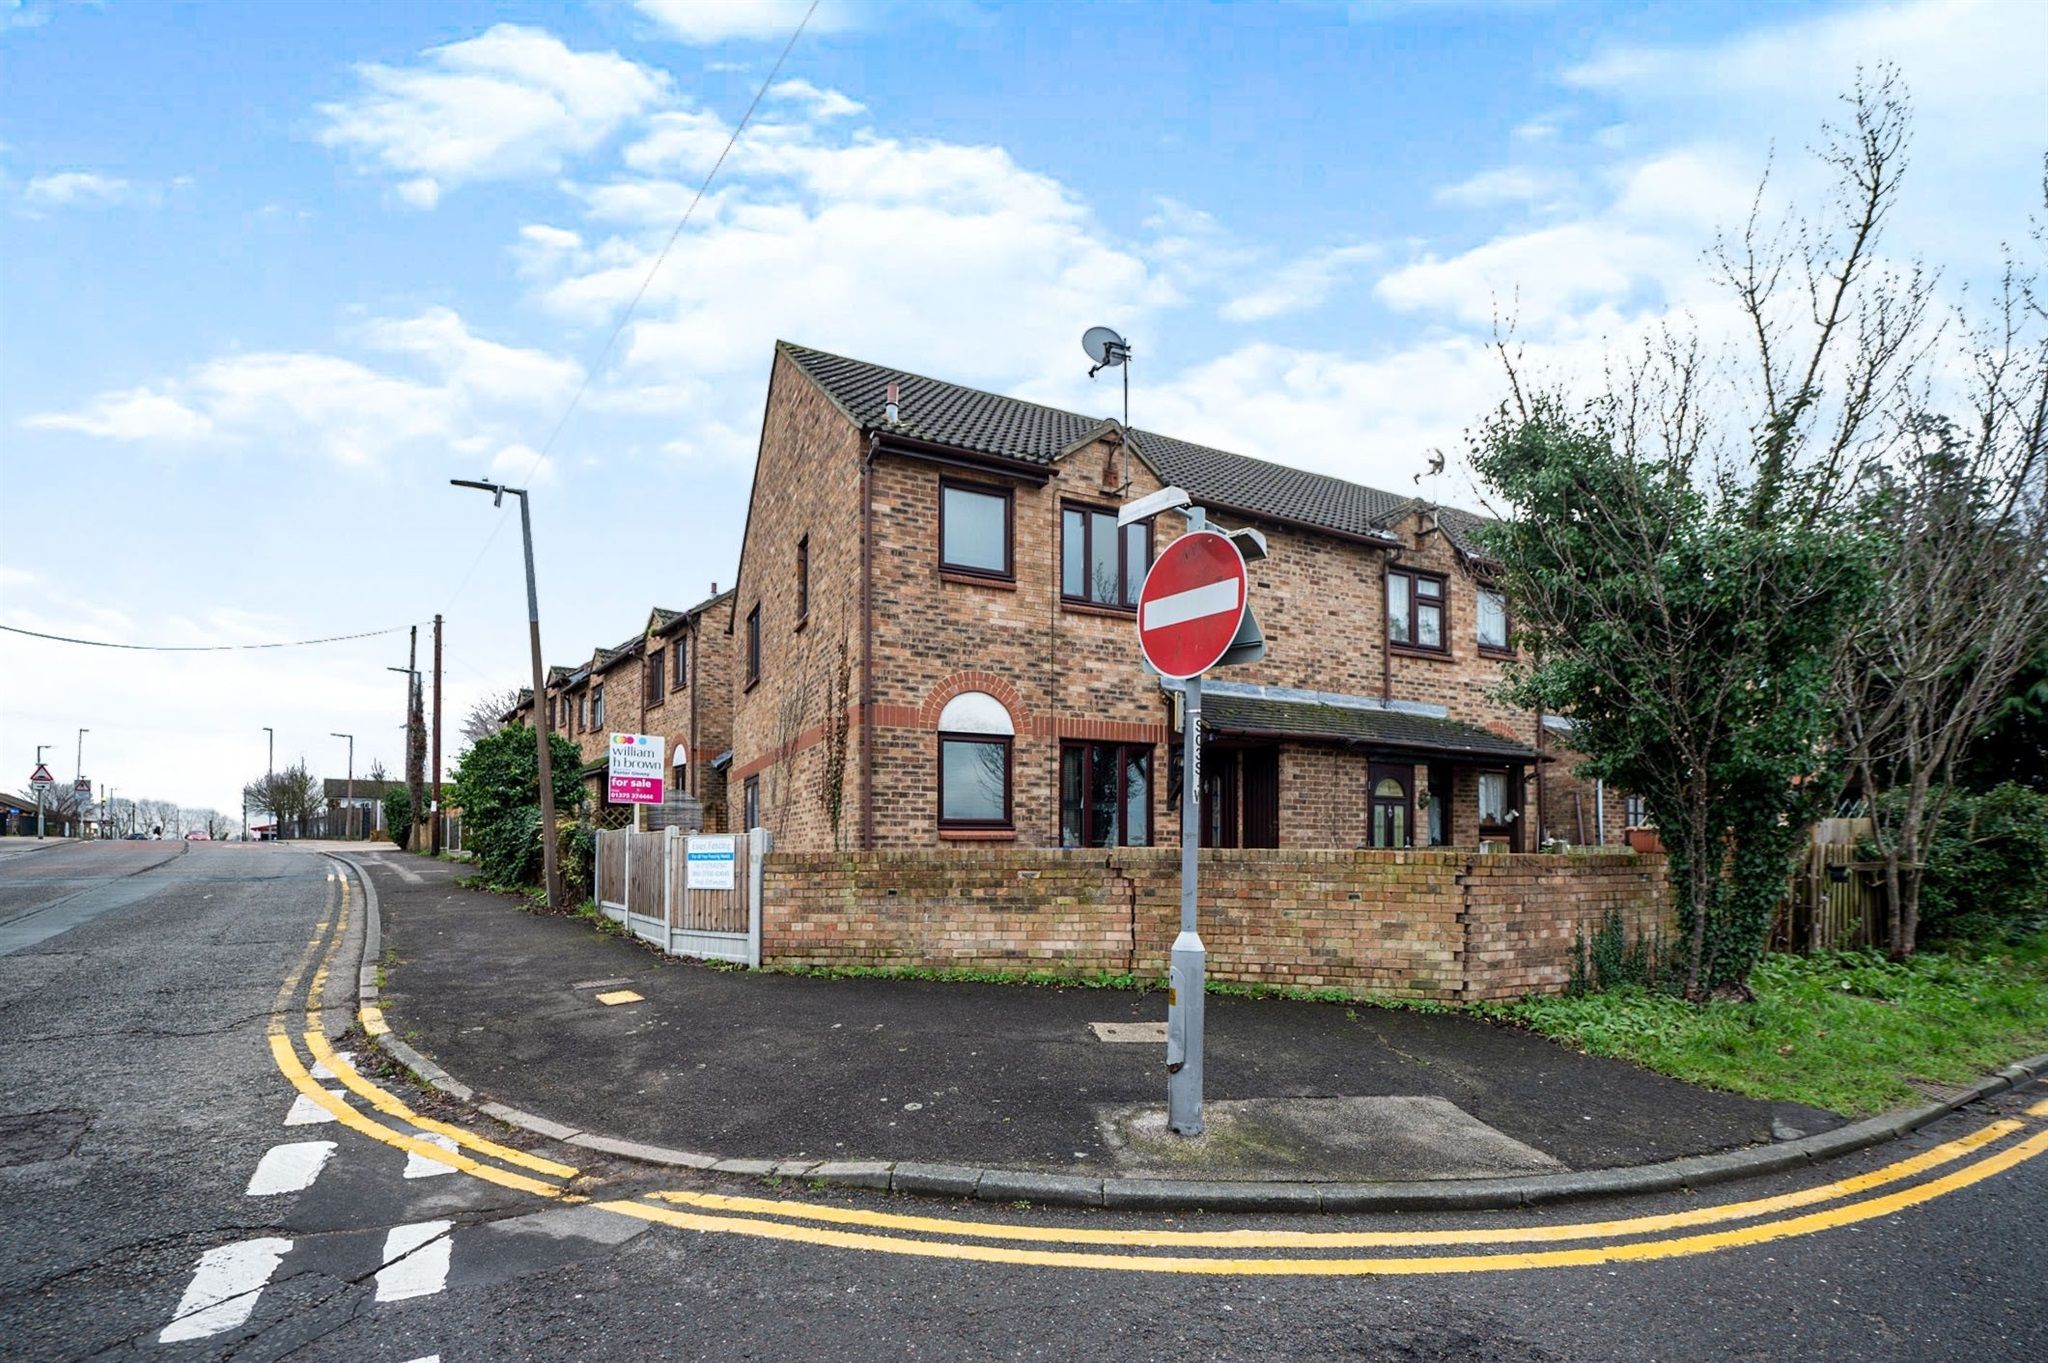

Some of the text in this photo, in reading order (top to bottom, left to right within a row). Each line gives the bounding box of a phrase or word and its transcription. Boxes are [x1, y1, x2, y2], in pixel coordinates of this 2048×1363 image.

[613, 746, 655, 758] william
[613, 757, 661, 769] h brown
[611, 778, 652, 788] for sale
